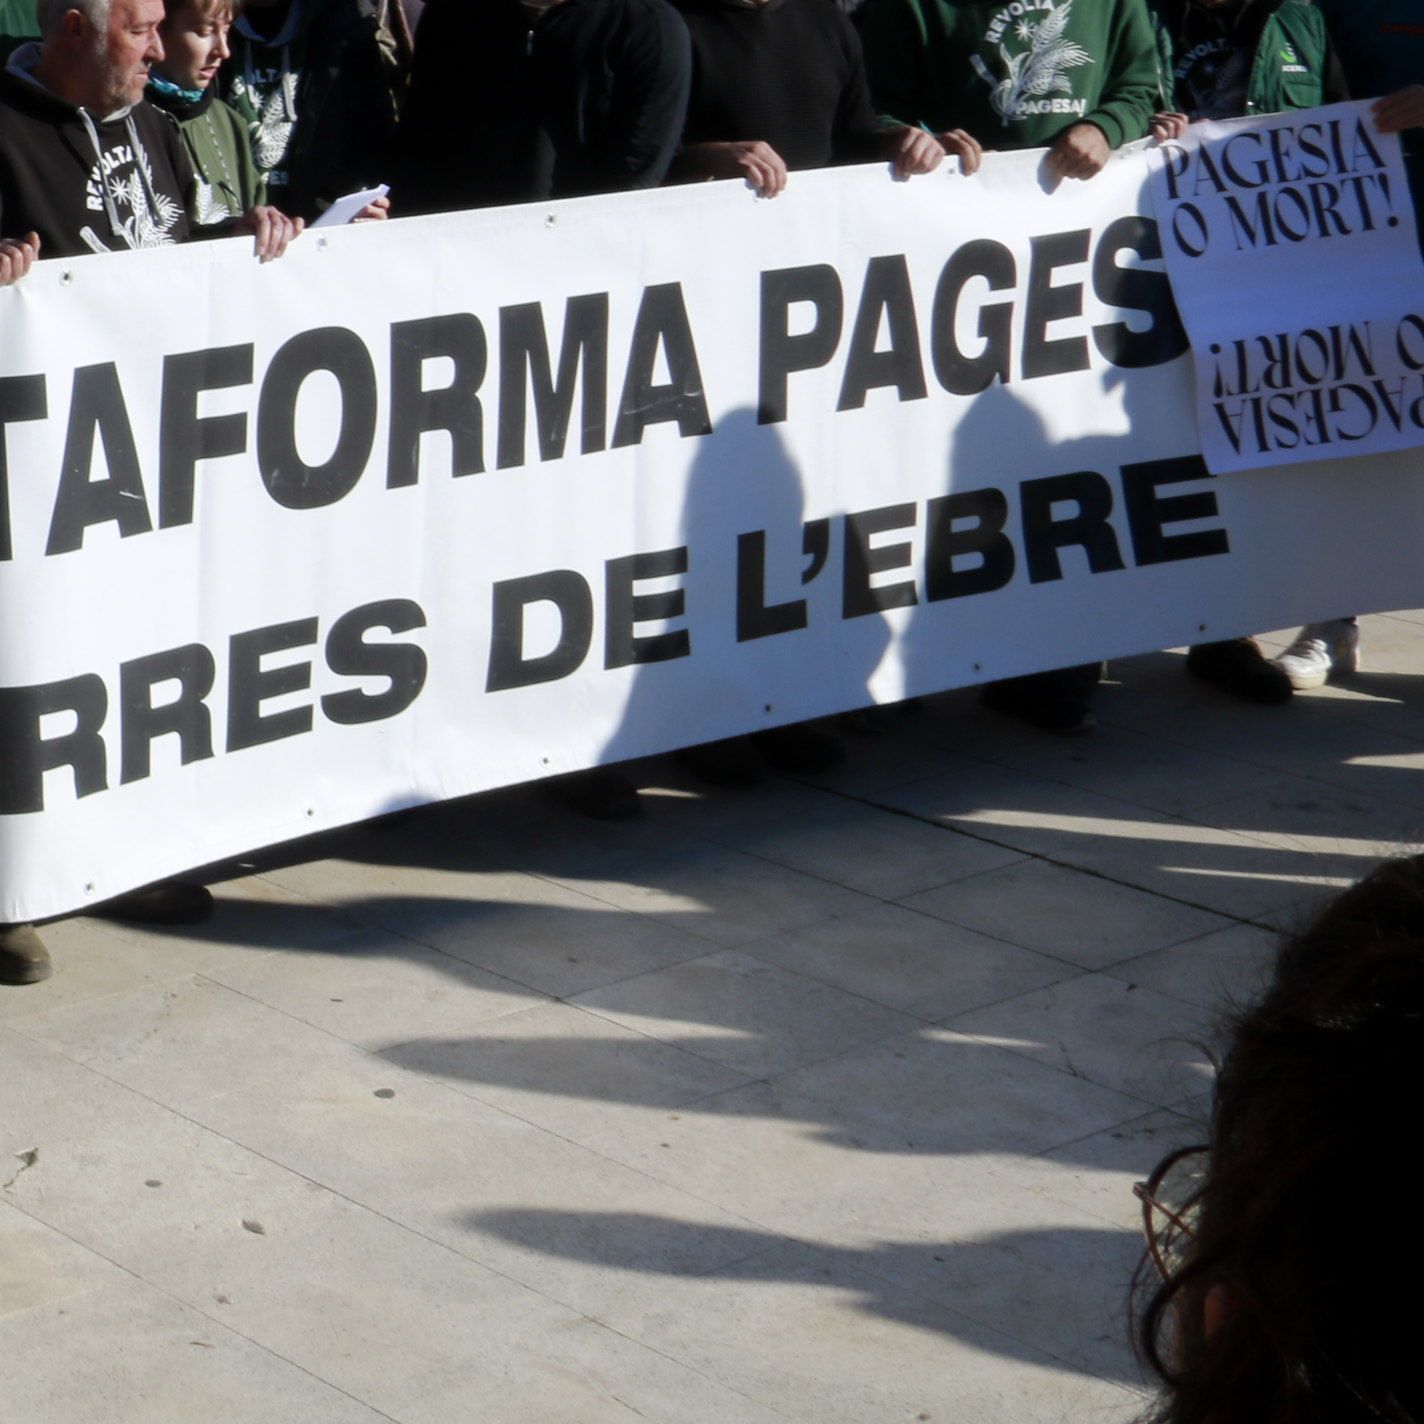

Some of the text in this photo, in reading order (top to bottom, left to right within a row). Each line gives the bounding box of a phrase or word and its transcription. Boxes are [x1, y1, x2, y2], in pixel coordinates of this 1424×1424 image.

[1174, 37, 1226, 79] REVOLT
[1015, 98, 1088, 118] PAGESA!
[1158, 116, 1387, 200] PAGESIA
[1172, 173, 1399, 258] O MORT!
[486, 547, 690, 694] DE
[735, 454, 1230, 643] L'EBRE
